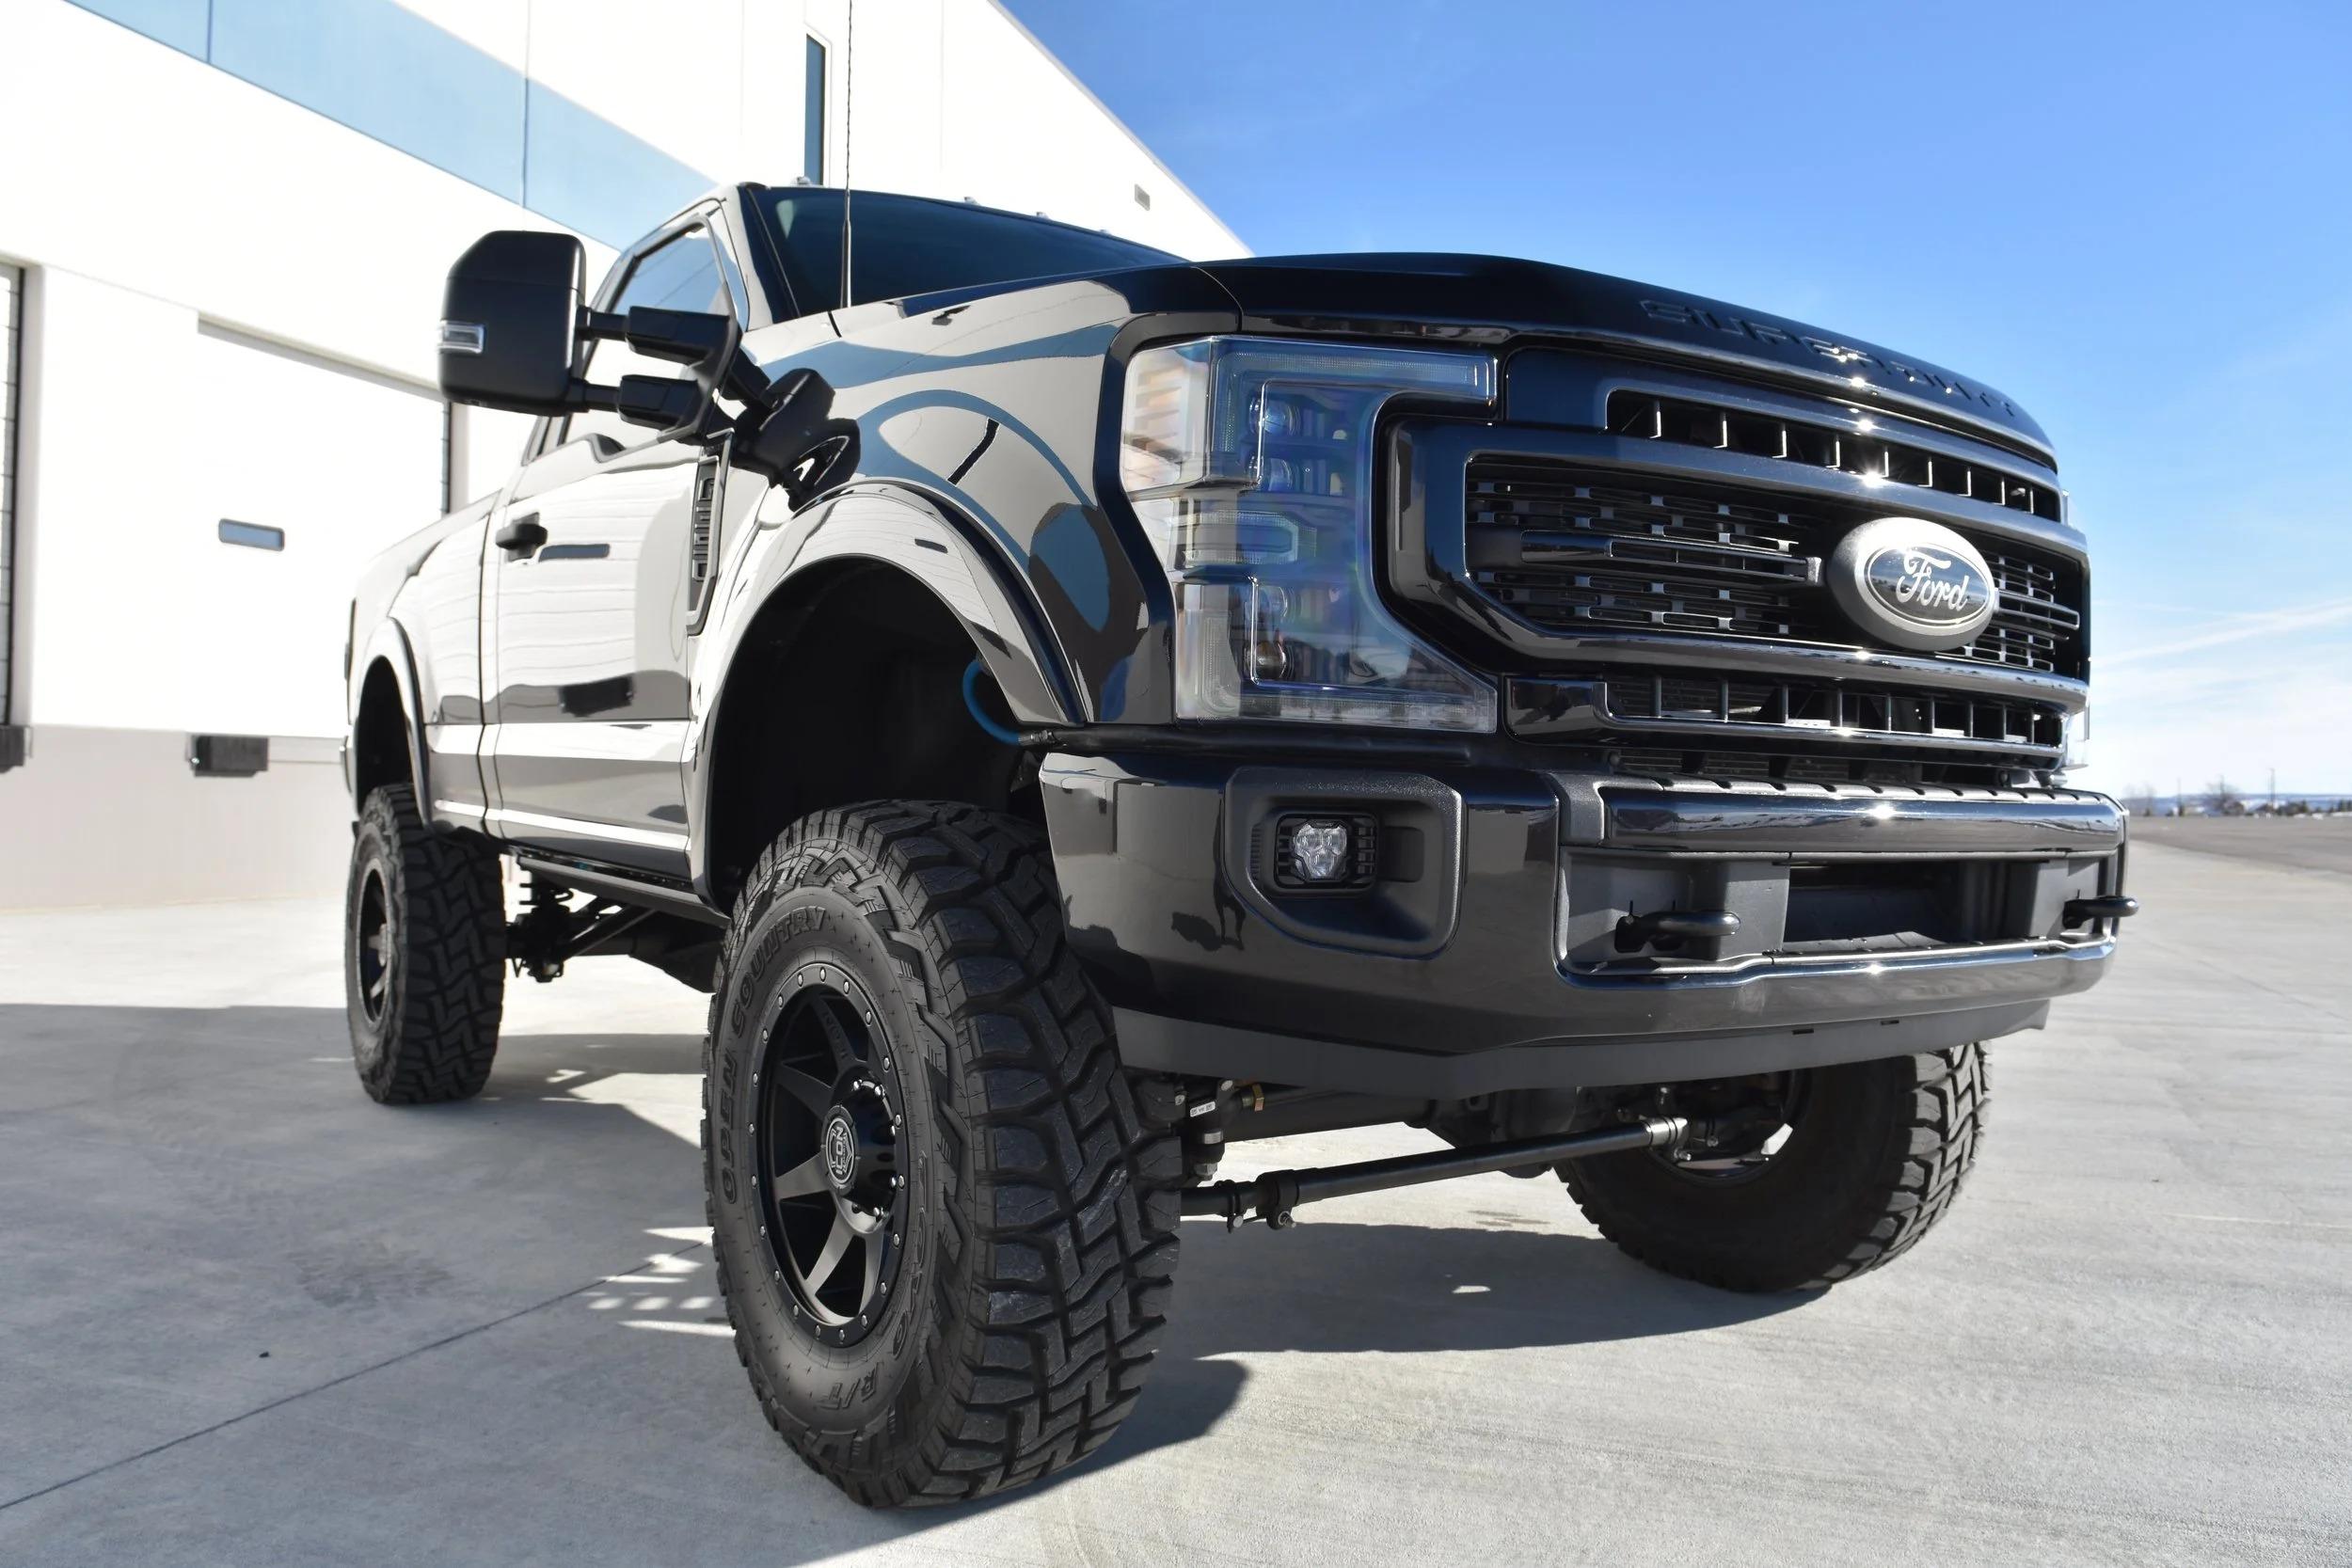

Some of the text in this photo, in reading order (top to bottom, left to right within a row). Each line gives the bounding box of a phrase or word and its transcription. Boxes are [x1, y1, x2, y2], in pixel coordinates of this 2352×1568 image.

[1896, 548, 1970, 611] Ford
[720, 906, 826, 1205] OPEN COUNTRY
[835, 1126, 844, 1175] ICON
